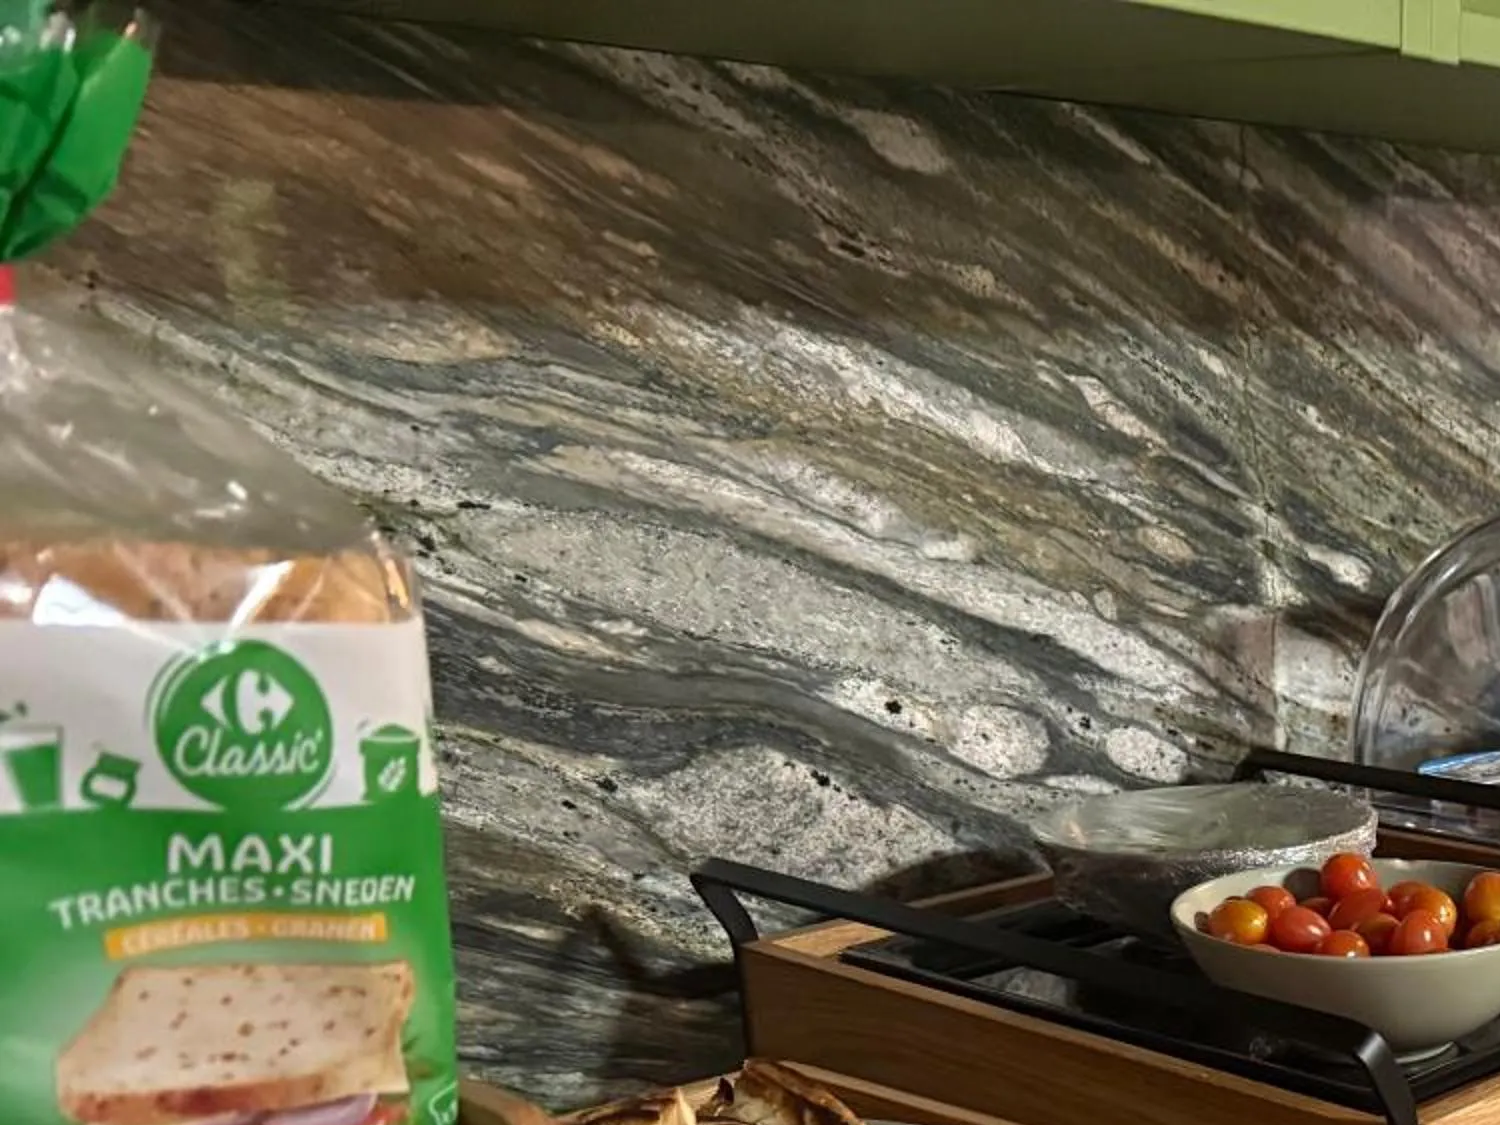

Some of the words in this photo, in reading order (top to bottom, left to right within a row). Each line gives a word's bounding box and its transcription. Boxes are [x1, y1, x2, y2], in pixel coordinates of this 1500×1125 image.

[167, 833, 333, 874] MAXI
[47, 876, 266, 930] TRANCHES
[291, 875, 415, 907] SNEDEN
